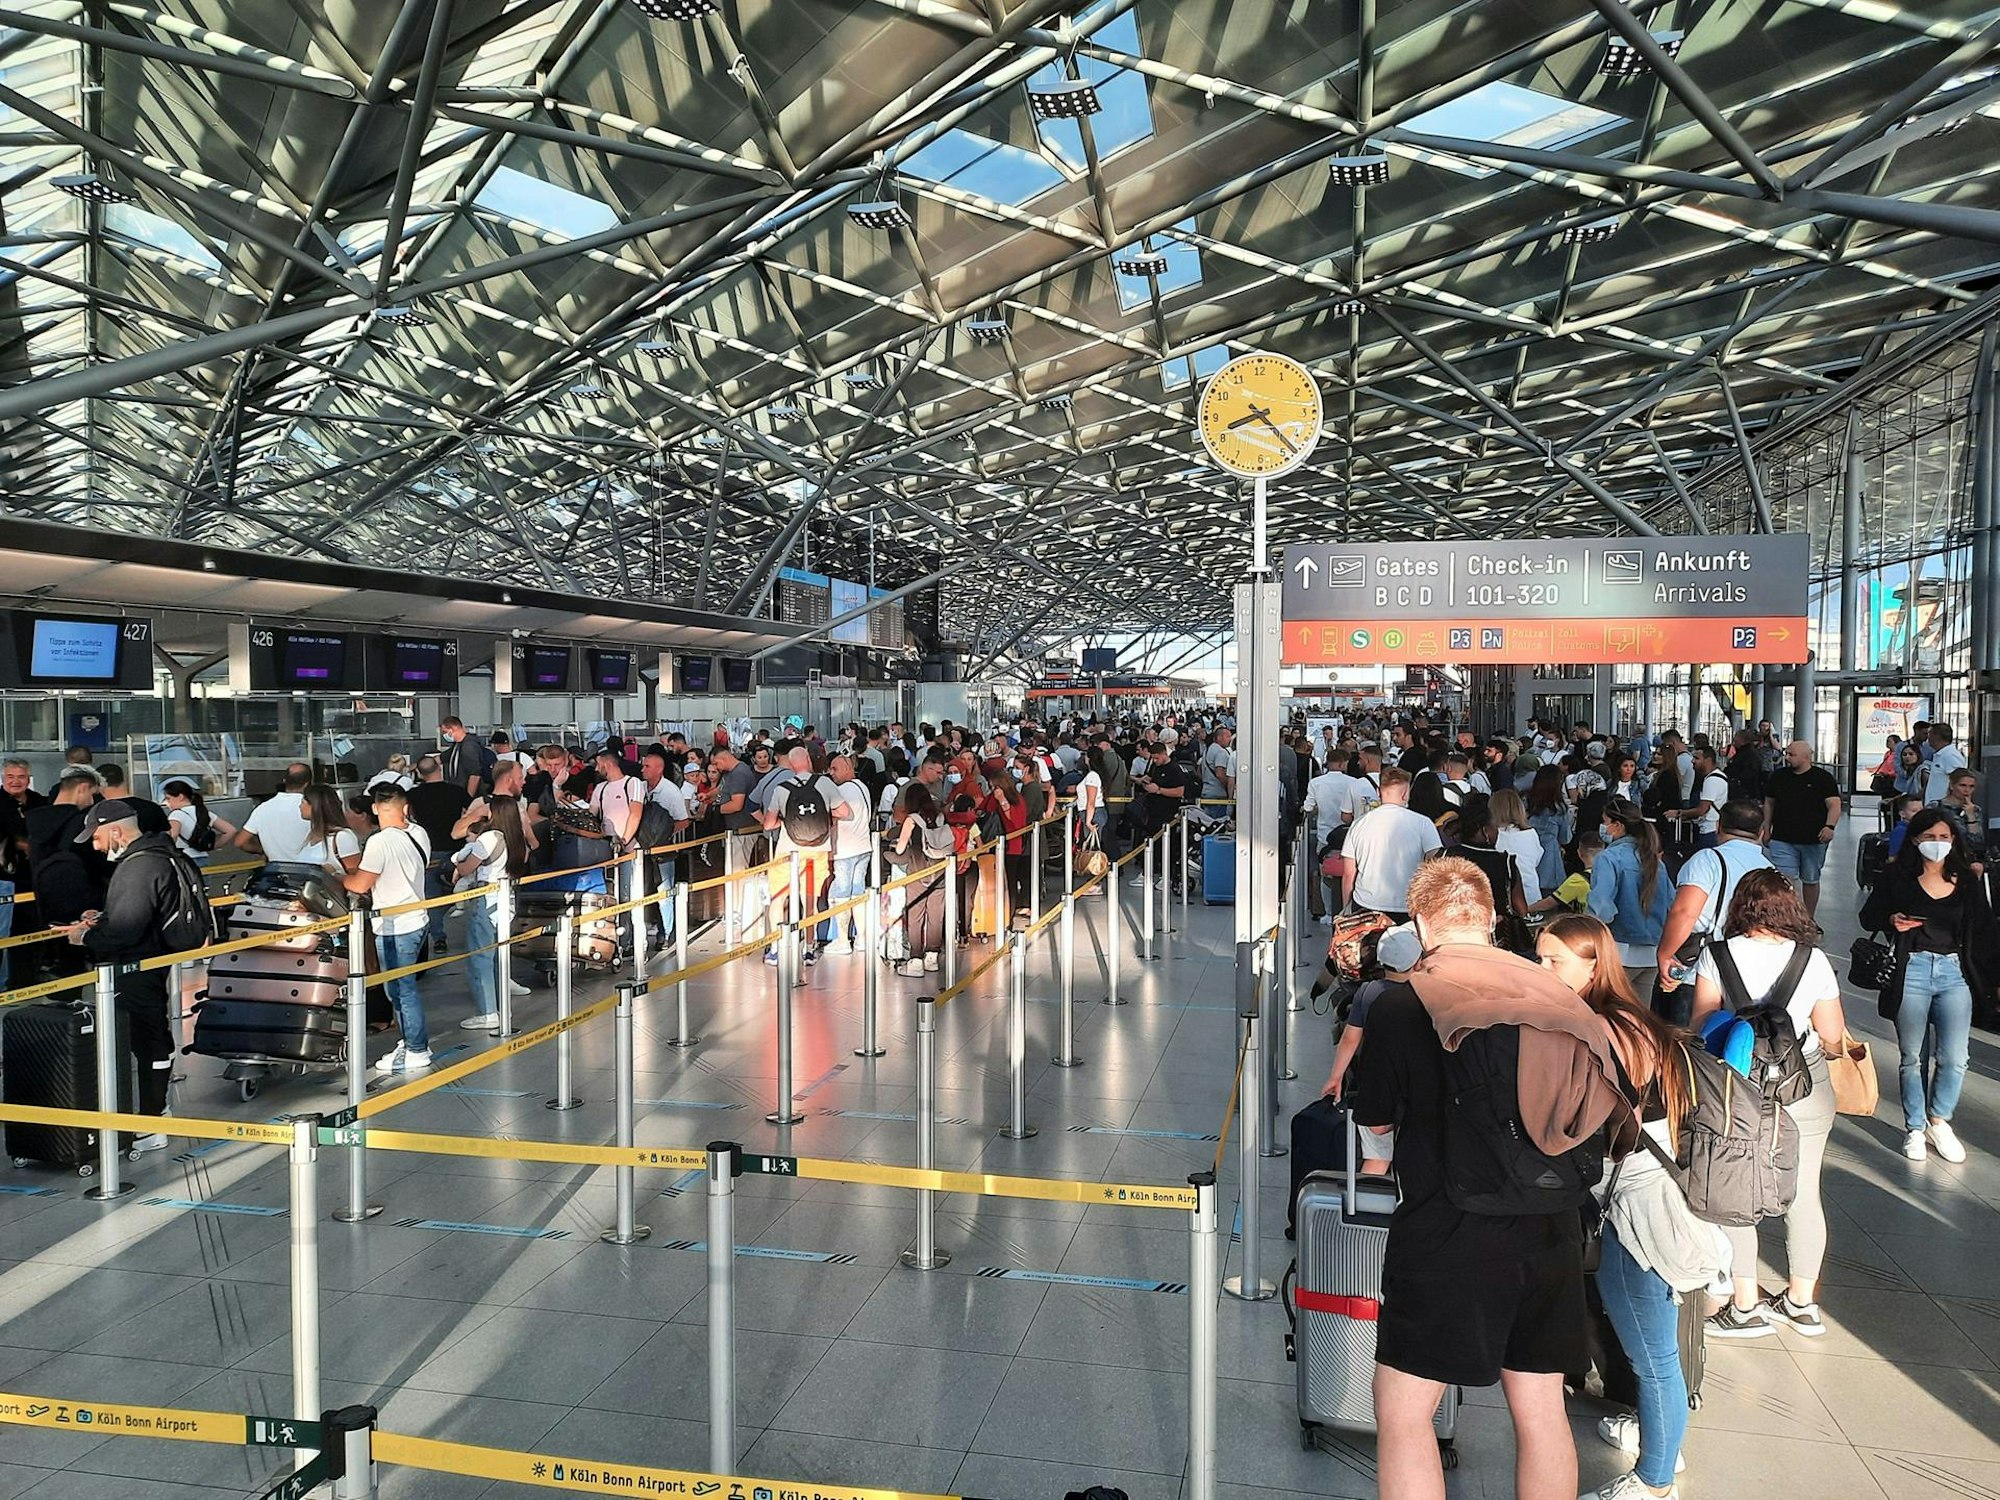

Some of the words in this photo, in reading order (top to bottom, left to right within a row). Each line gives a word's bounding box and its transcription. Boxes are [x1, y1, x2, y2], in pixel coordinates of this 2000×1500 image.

[1254, 366, 1266, 376] 12
[1233, 375, 1243, 385] 11
[1279, 372, 1284, 382] 1
[1217, 391, 1228, 401] 10
[1294, 388, 1300, 397] 2
[1212, 413, 1219, 422] 9
[1301, 408, 1307, 417] 3
[1220, 433, 1226, 443] 8
[1235, 450, 1240, 459] 7
[1280, 448, 1286, 456] 5
[1257, 455, 1264, 463] 6
[1467, 553, 1569, 575] Check-in
[1655, 550, 1751, 571] Ankunft
[1375, 556, 1439, 576] Gates
[1375, 586, 1388, 606] B
[1397, 586, 1410, 606] C
[1419, 586, 1433, 606] D
[1466, 584, 1560, 606] 101-320
[1654, 582, 1747, 603] Arrivals
[123, 623, 148, 641] 427
[1558, 627, 1578, 638] Zoll
[252, 631, 274, 647] 426
[1481, 629, 1502, 649] PN
[245, 1128, 261, 1138] Köln
[262, 1129, 279, 1138] Bonn
[661, 1154, 678, 1164] Köln
[680, 1155, 699, 1164] Bonn
[1130, 1191, 1150, 1201] Köln
[1152, 1193, 1174, 1202] Bonn
[97, 1412, 121, 1426] Köln
[126, 1415, 151, 1428] Bonn
[155, 1417, 198, 1433] Airport
[570, 1468, 598, 1484] Köln
[603, 1471, 633, 1488] Bonn
[638, 1475, 686, 1494] Airport
